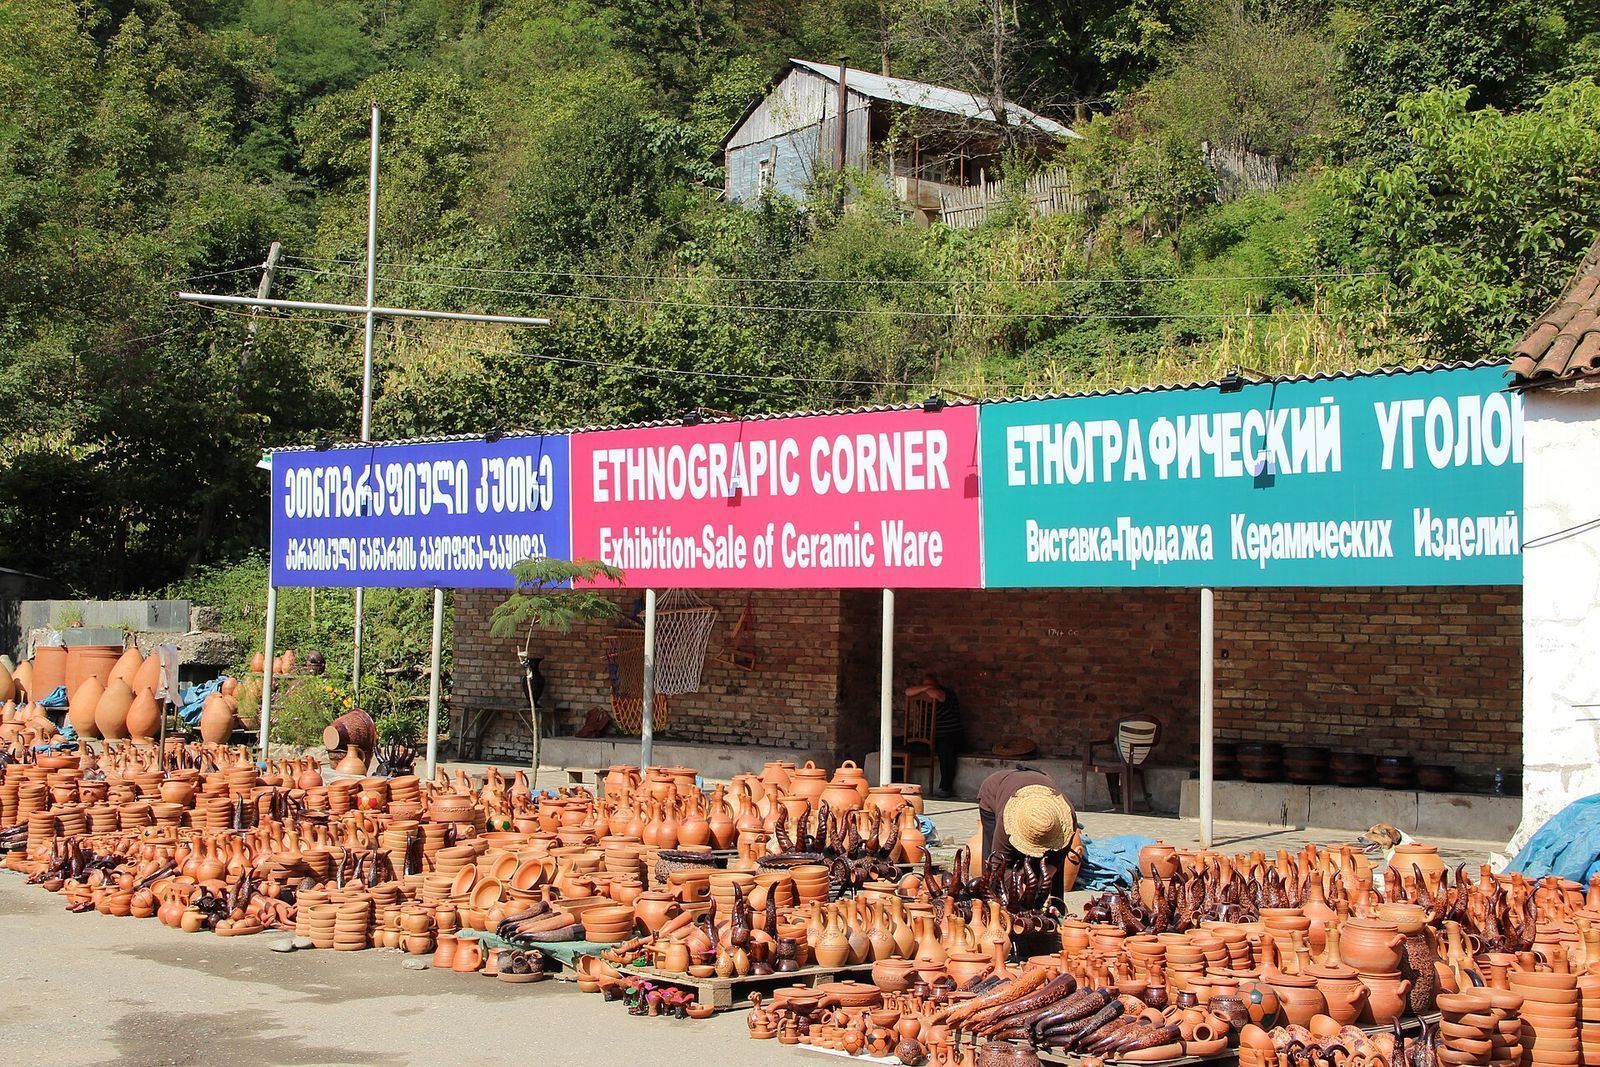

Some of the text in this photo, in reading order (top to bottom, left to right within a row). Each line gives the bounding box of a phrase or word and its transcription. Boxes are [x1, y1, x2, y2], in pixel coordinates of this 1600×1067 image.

[593, 429, 952, 503] ETHNOGRAPIC CORNER
[1006, 397, 1342, 486] ЕТНОГРАФИЧЕСКИЙ
[285, 454, 553, 519] ეთნოგრაფიული კუთხე
[286, 537, 357, 571] კერამიკული
[359, 536, 417, 571] ნაწარმის
[599, 518, 944, 569] Exhibition-Sale of Ceramic Ware
[1026, 507, 1519, 571] Виставка-Продажа Керамических Изделий
